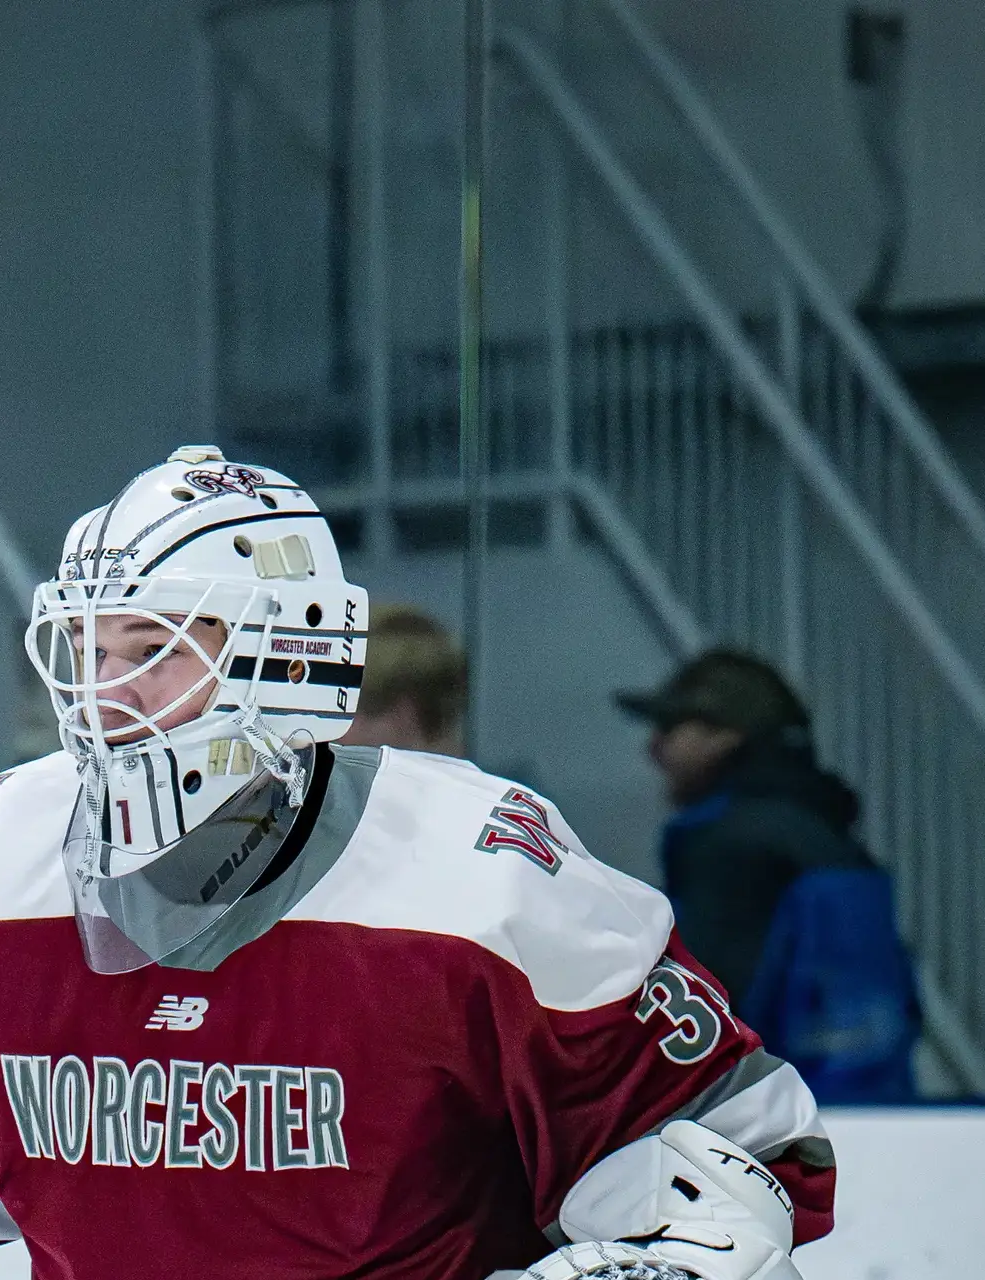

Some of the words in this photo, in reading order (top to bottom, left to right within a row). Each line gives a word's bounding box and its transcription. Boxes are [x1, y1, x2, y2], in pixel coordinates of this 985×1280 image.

[271, 638, 304, 655] WORCESTER
[305, 641, 333, 657] ACADEMY
[116, 800, 132, 845] 1
[474, 787, 569, 877] W
[0, 1054, 350, 1171] WORCESTER
[707, 1147, 794, 1220] TRU
